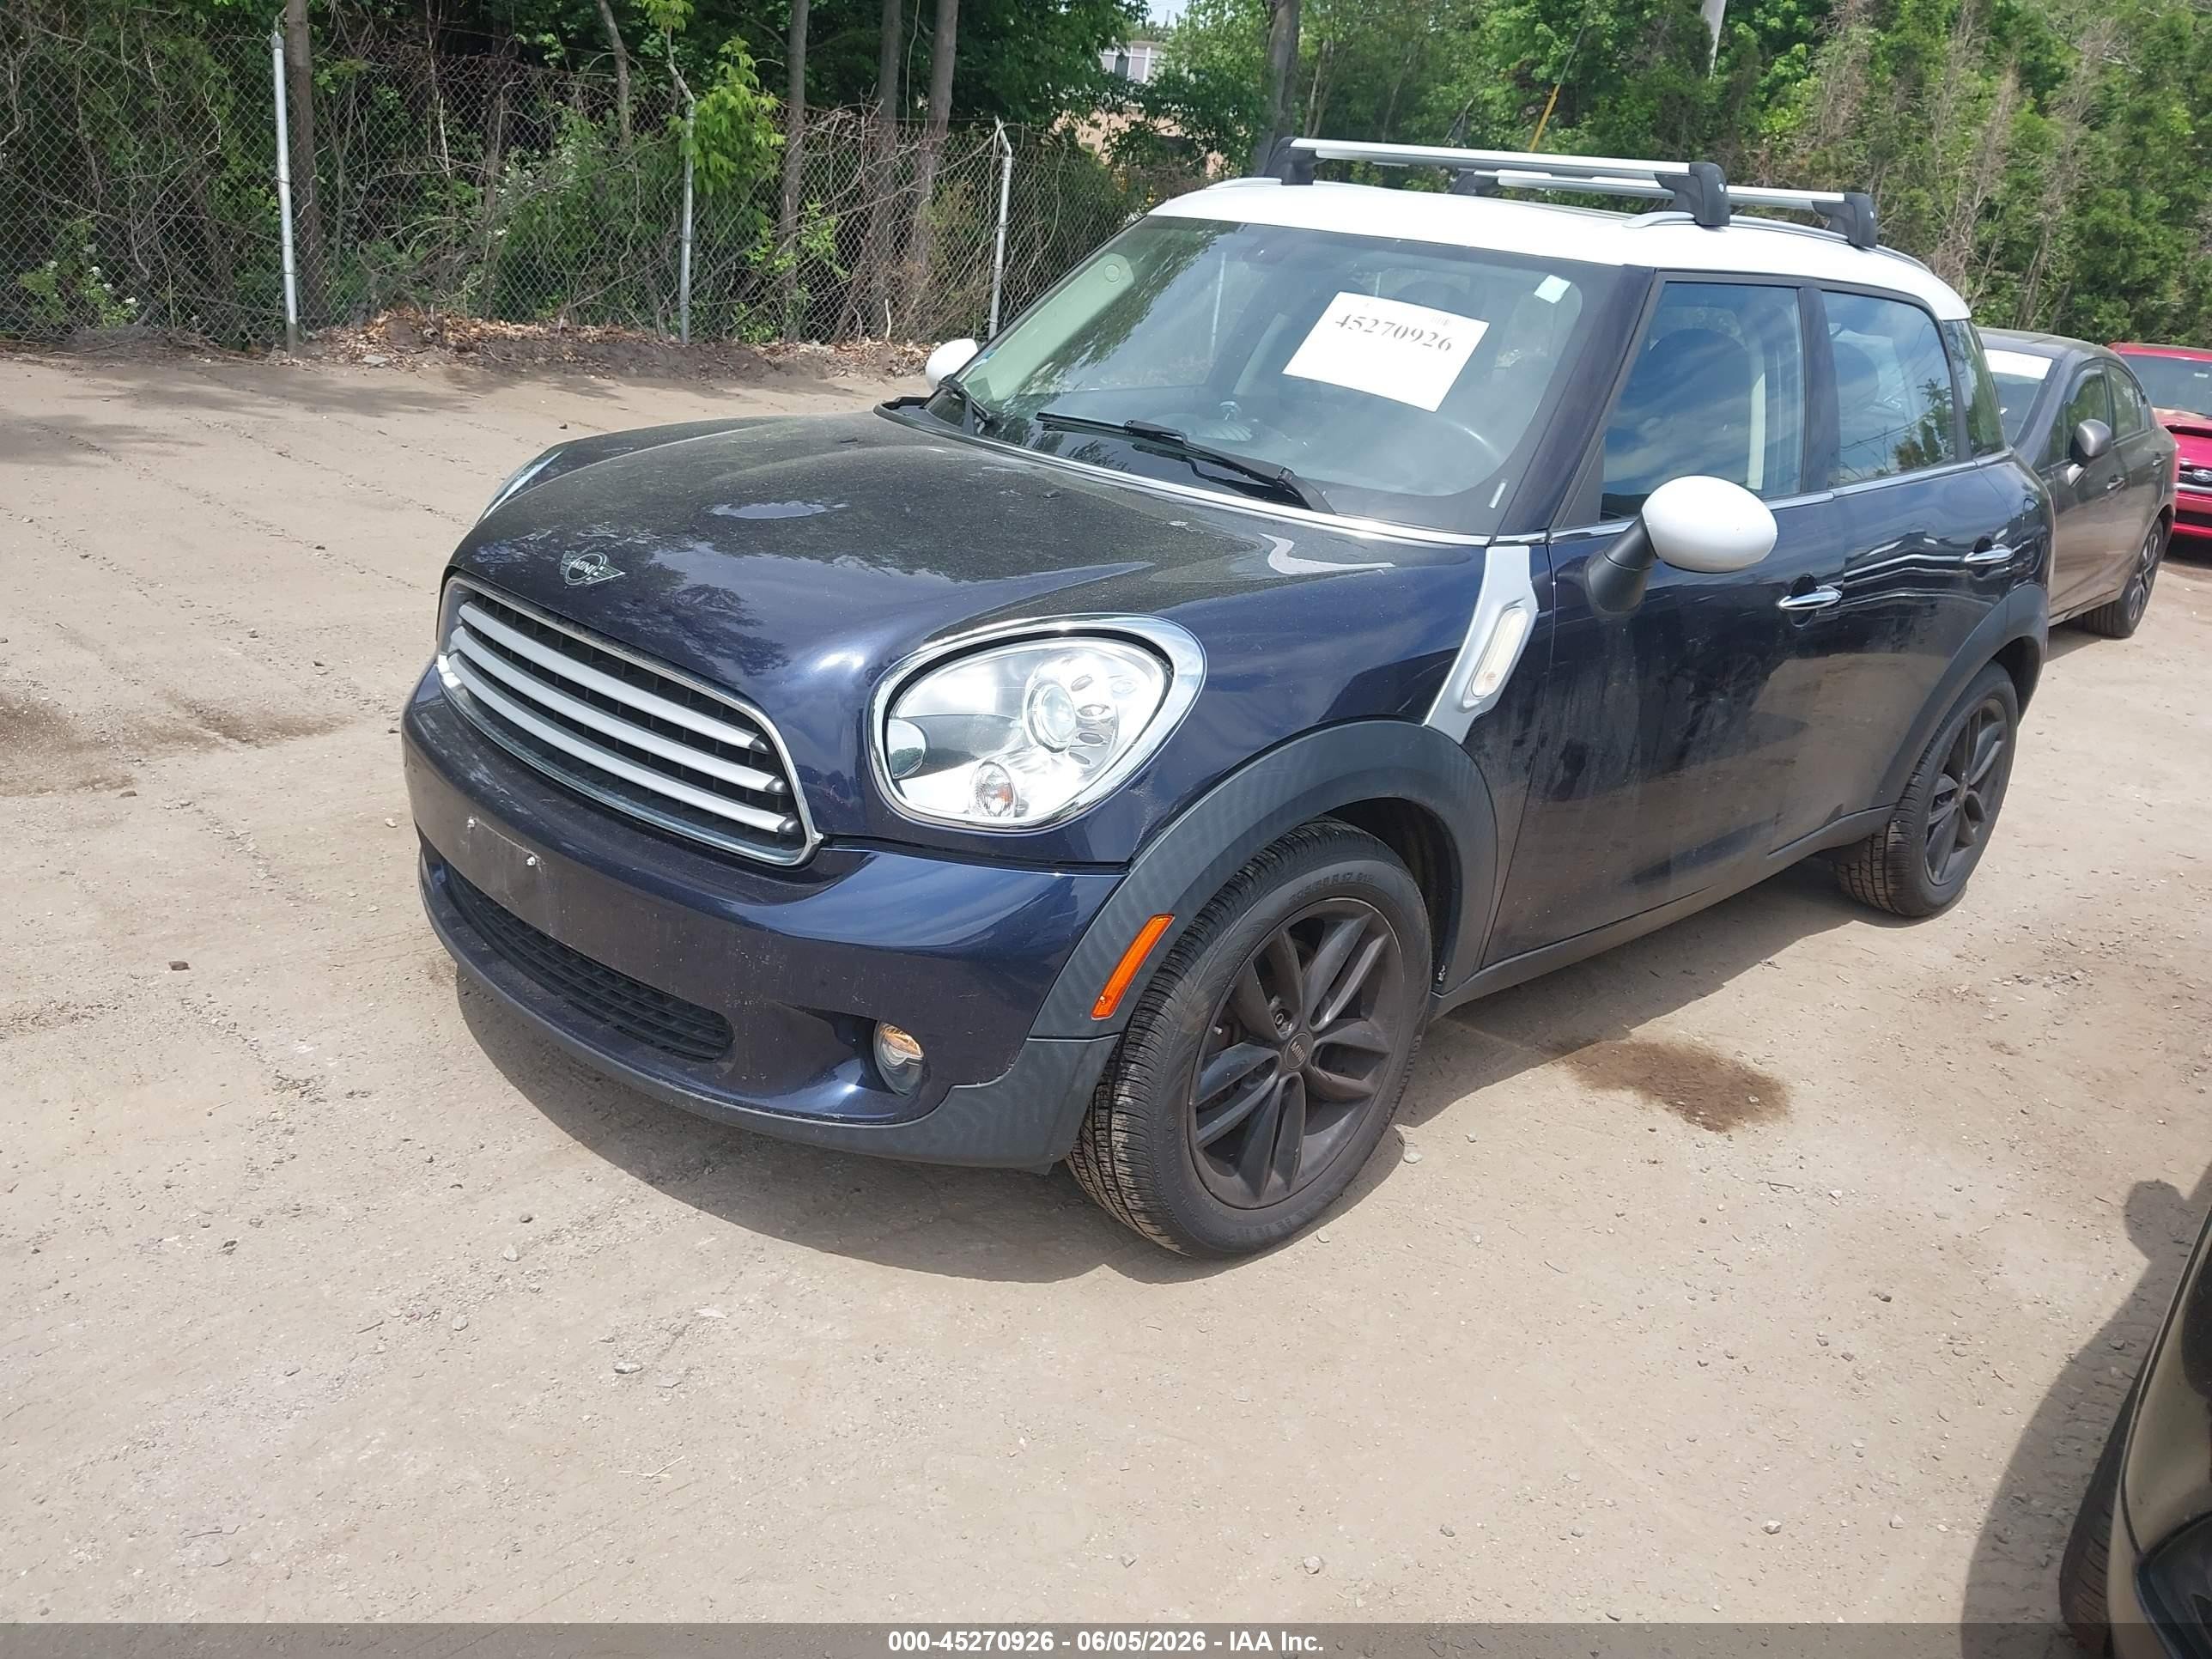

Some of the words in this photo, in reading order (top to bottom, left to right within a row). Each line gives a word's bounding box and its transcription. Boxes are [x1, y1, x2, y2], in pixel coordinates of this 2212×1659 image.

[1334, 313, 1453, 352] 45270926
[571, 559, 599, 574] MINI
[1290, 1041, 1306, 1062] MINI
